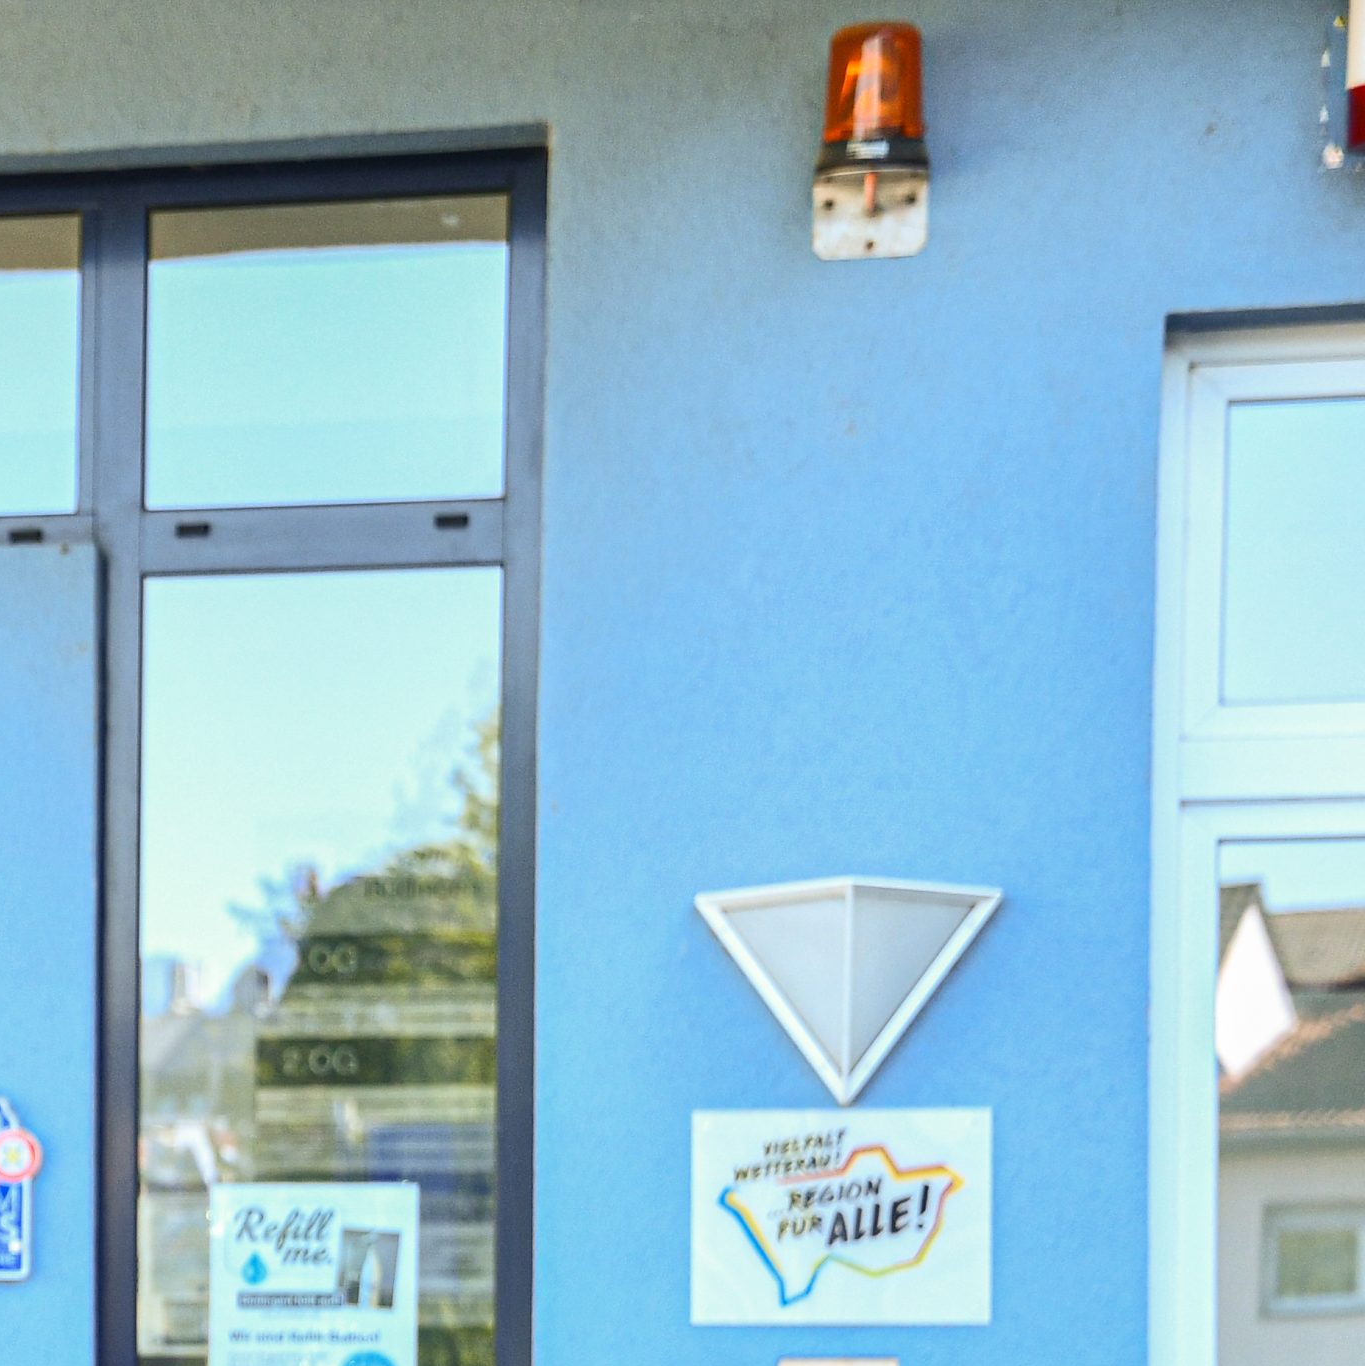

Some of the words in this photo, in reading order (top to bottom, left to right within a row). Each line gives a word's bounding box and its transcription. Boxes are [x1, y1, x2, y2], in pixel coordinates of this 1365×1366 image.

[764, 1127, 846, 1156] VIELFALT
[787, 1177, 883, 1210] REGION
[234, 1206, 336, 1252] Refill
[827, 1184, 930, 1247] ALLE!
